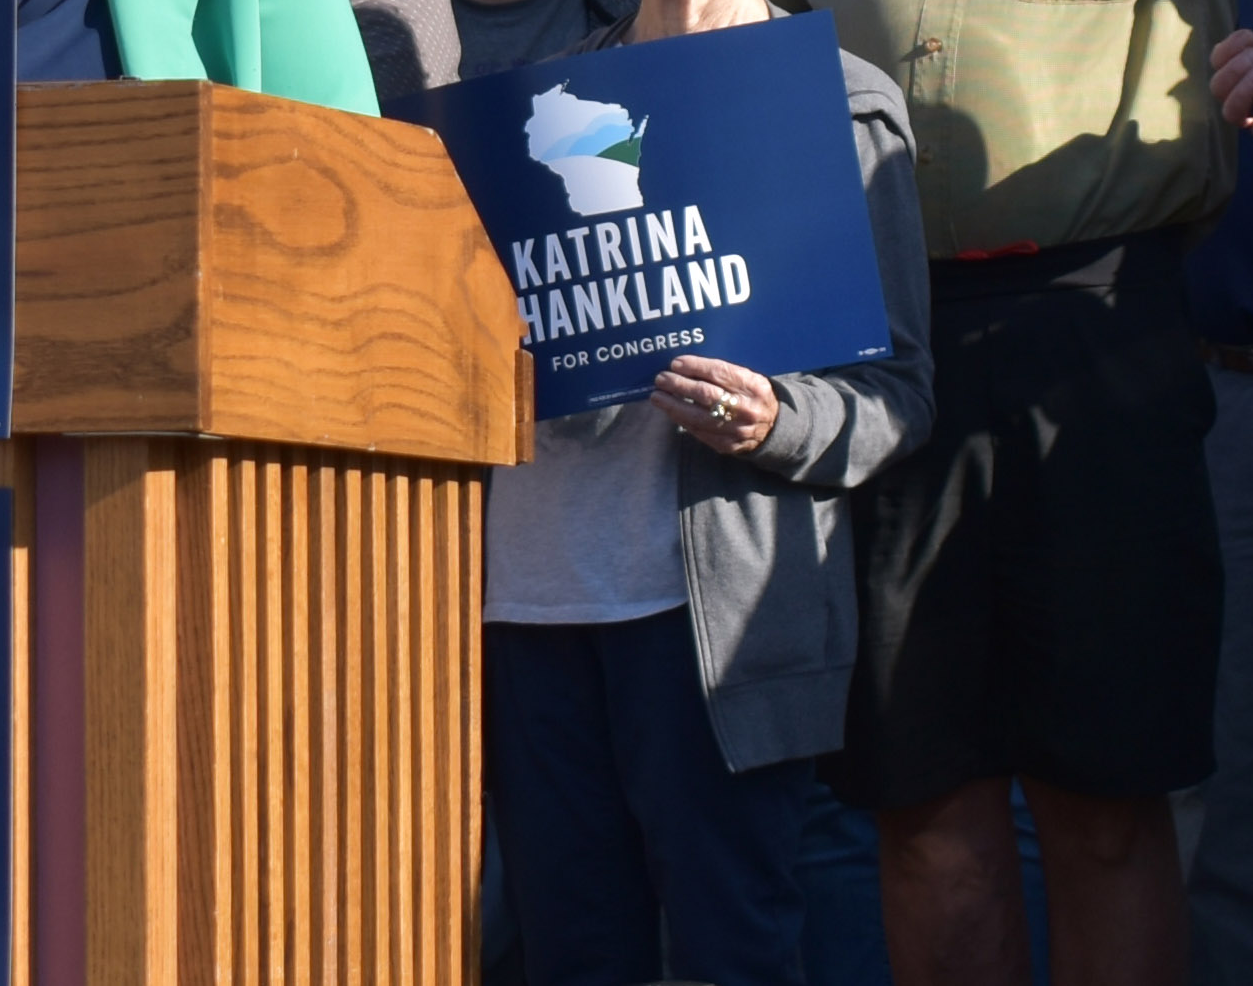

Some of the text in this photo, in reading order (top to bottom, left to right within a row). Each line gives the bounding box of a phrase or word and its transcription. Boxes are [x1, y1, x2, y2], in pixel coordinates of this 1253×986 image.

[511, 204, 714, 290] KATRINA
[518, 253, 752, 346] HANKLAND
[551, 327, 706, 372] FOR CONGRESS
